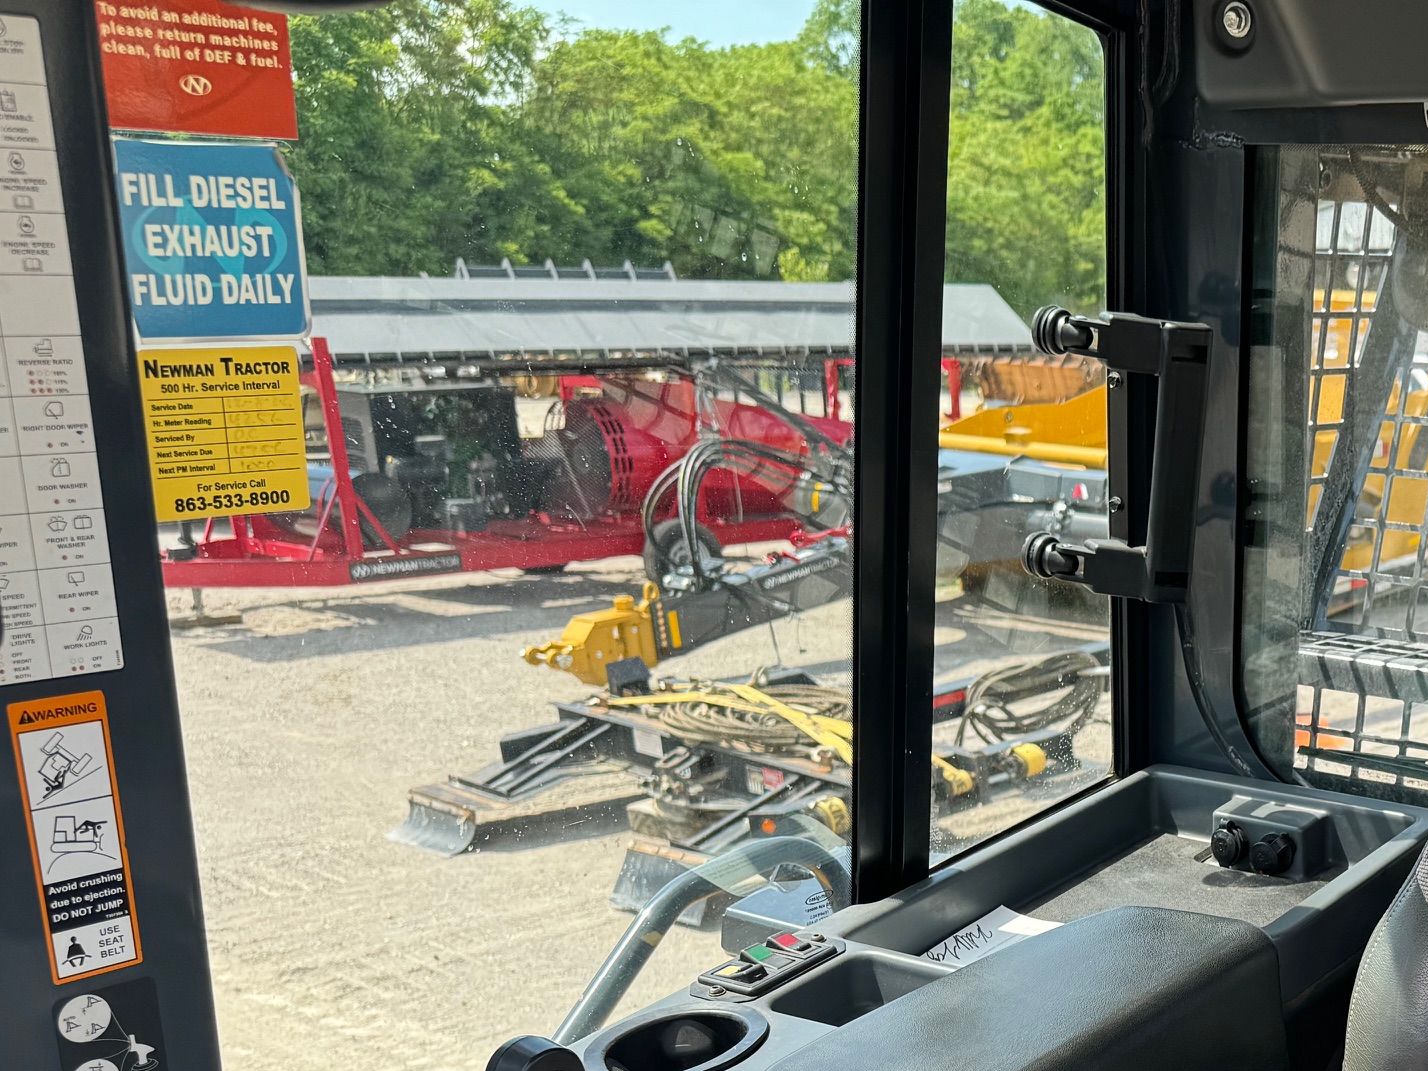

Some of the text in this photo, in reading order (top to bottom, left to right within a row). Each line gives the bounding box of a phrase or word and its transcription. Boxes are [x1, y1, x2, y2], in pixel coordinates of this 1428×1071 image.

[100, 2, 278, 35] To avoid an additional fee,
[100, 21, 278, 51] please return machines
[102, 40, 283, 69] clean, full of DEF & fuel.
[121, 172, 286, 210] FILL DIESEL
[144, 224, 272, 257] EXHAUST
[131, 274, 294, 306] FLUID DAILY
[144, 358, 290, 378] NEWMAN TRACTOR
[161, 380, 280, 393] 500 Hr. Service Interval
[151, 403, 177, 412] Service
[164, 418, 183, 426] Meter
[184, 418, 212, 427] Reading
[155, 434, 195, 443] Serviced By
[174, 450, 198, 458] Service
[158, 466, 176, 474] Next
[189, 464, 216, 472] Interval
[197, 479, 266, 492] For Service Call
[174, 490, 290, 512] 863-533-8900
[85, 640, 108, 648] LIGHTS
[32, 702, 97, 721] WARNING
[48, 874, 122, 895] Avoid crushing
[50, 886, 126, 909] due to ejection.
[52, 912, 70, 922] DO
[71, 906, 93, 918] NOT
[95, 899, 124, 912] JUMP
[100, 924, 120, 936] USE
[98, 934, 124, 948] SEAT
[100, 946, 126, 958] BELT
